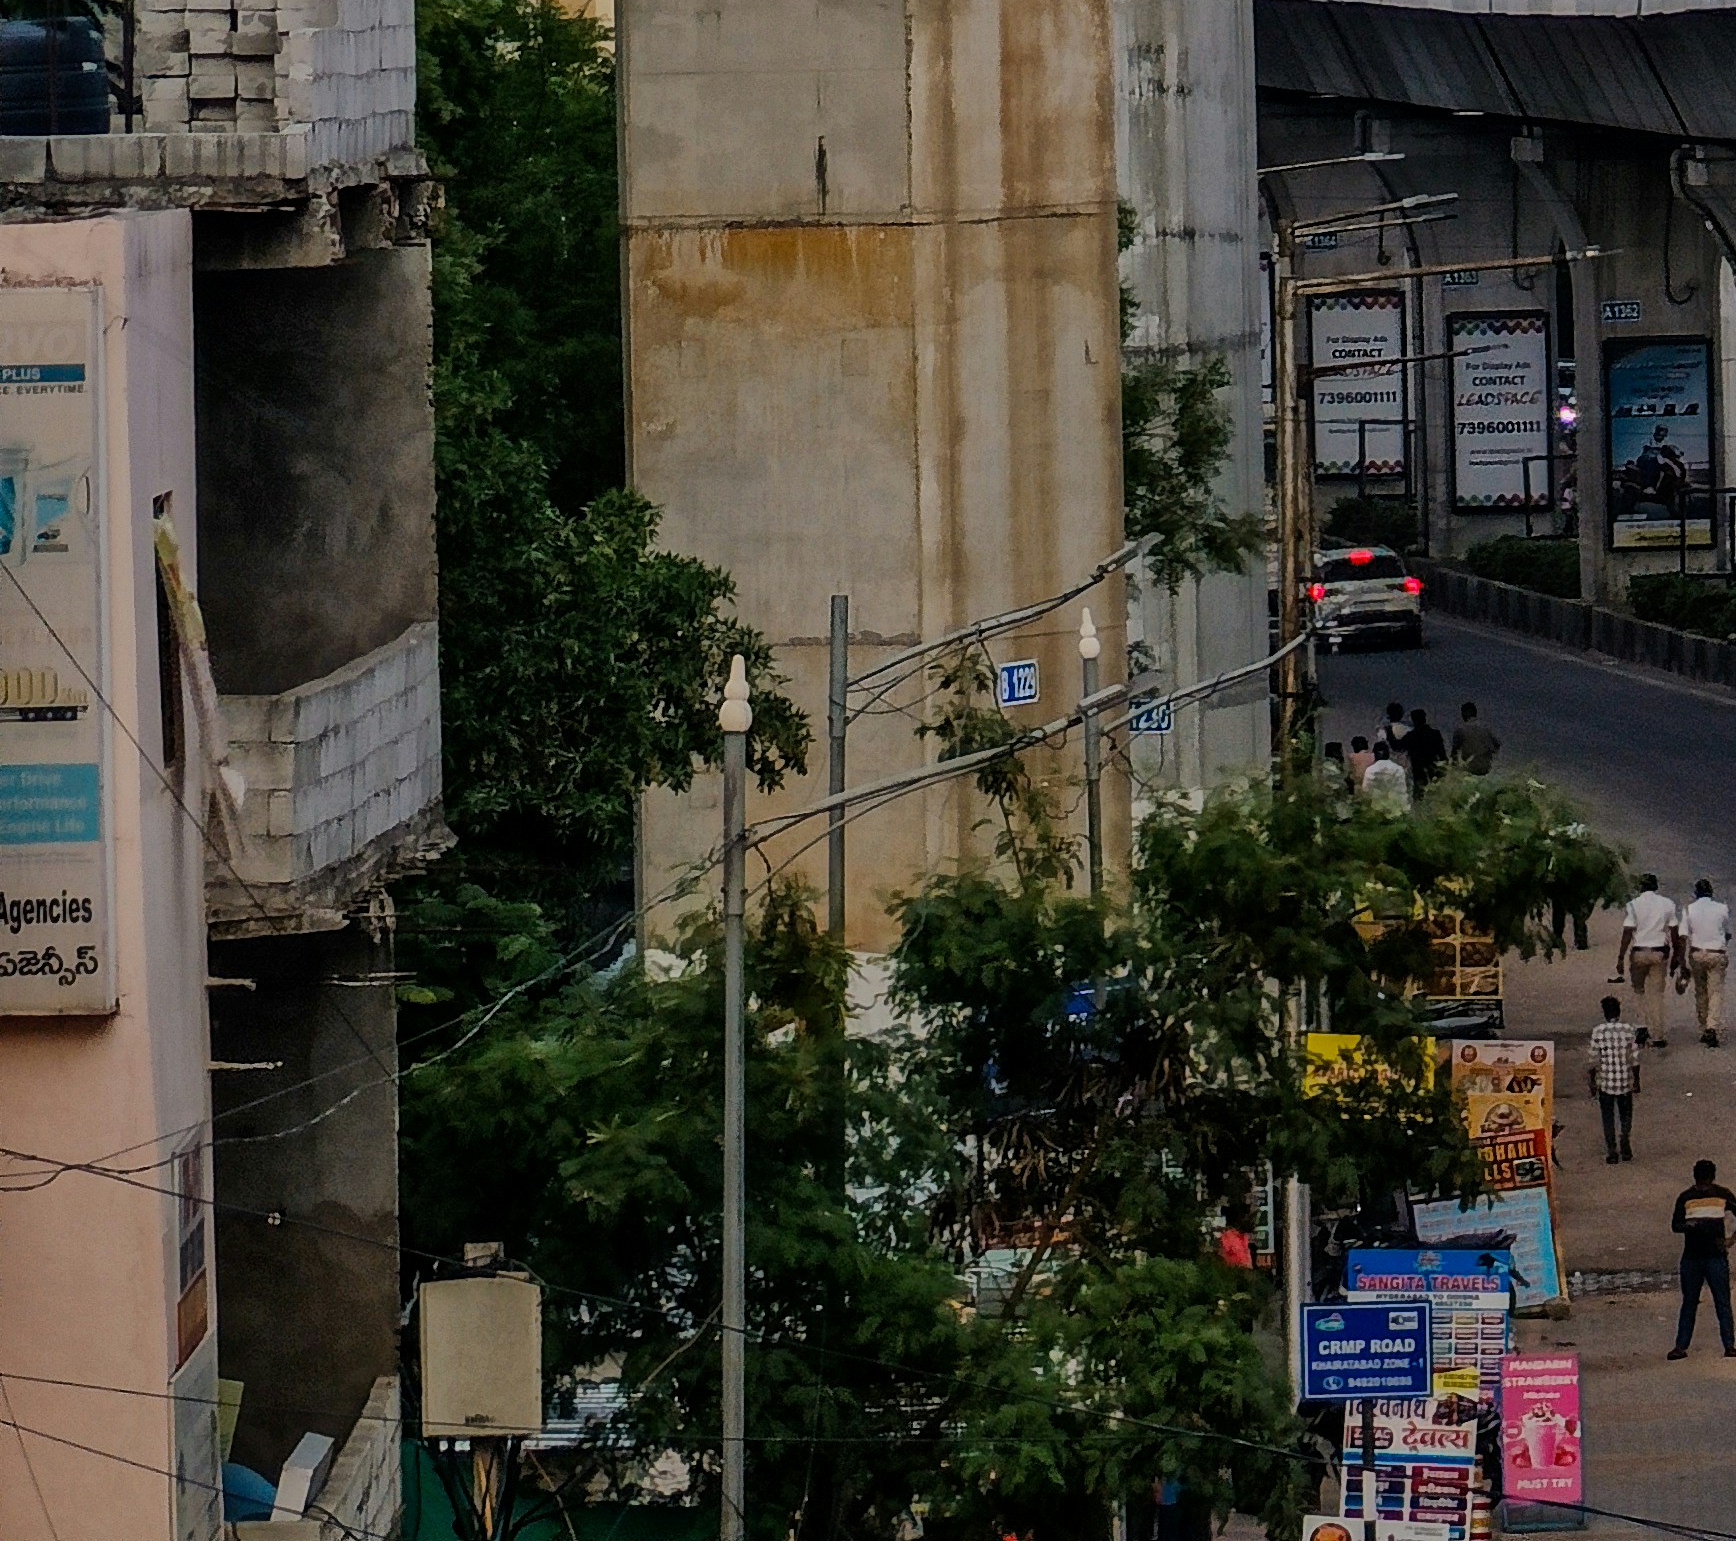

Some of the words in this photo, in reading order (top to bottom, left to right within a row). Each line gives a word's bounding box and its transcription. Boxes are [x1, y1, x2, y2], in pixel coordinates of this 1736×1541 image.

[1331, 348, 1384, 359] CONTACT
[2, 367, 41, 381] PLUS
[1472, 375, 1526, 386] CONTACT
[1319, 391, 1398, 404] 7396001111
[1457, 420, 1541, 435] 7396001111
[1356, 1274, 1425, 1291] SANGITA
[1428, 1274, 1500, 1291] TRAVELS
[1318, 1339, 1366, 1356] CRMP
[1370, 1338, 1416, 1354] ROAD
[1517, 1478, 1549, 1490] MUST
[1551, 1477, 1574, 1488] TRY
